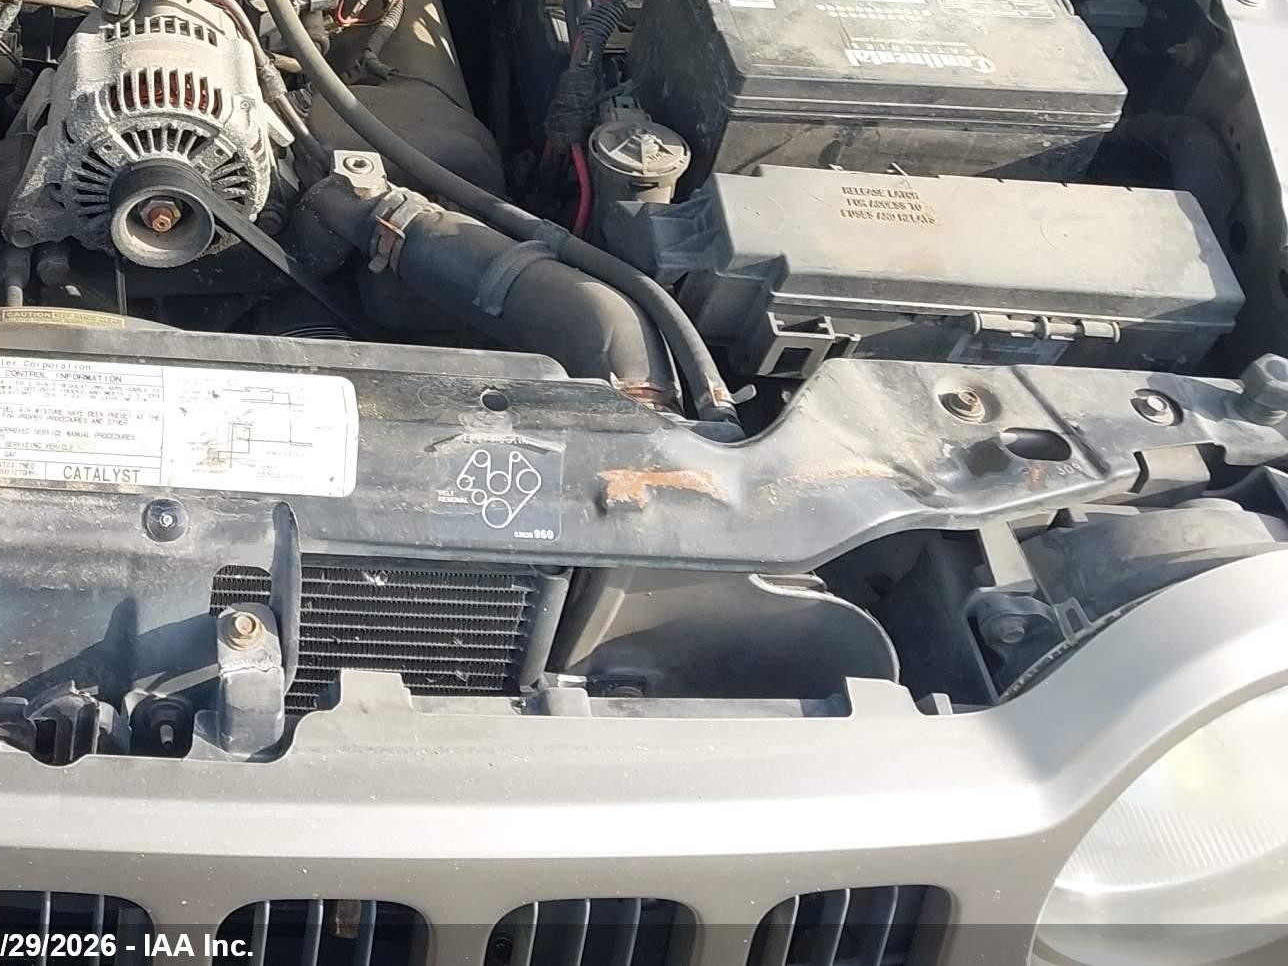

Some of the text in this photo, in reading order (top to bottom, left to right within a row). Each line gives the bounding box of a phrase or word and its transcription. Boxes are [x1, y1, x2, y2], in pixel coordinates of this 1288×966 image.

[844, 47, 998, 75] Continental
[24, 359, 92, 372] Corporation
[4, 369, 47, 380] CONTROL
[55, 371, 123, 383] INFORMATION
[63, 465, 141, 484] CATALYST
